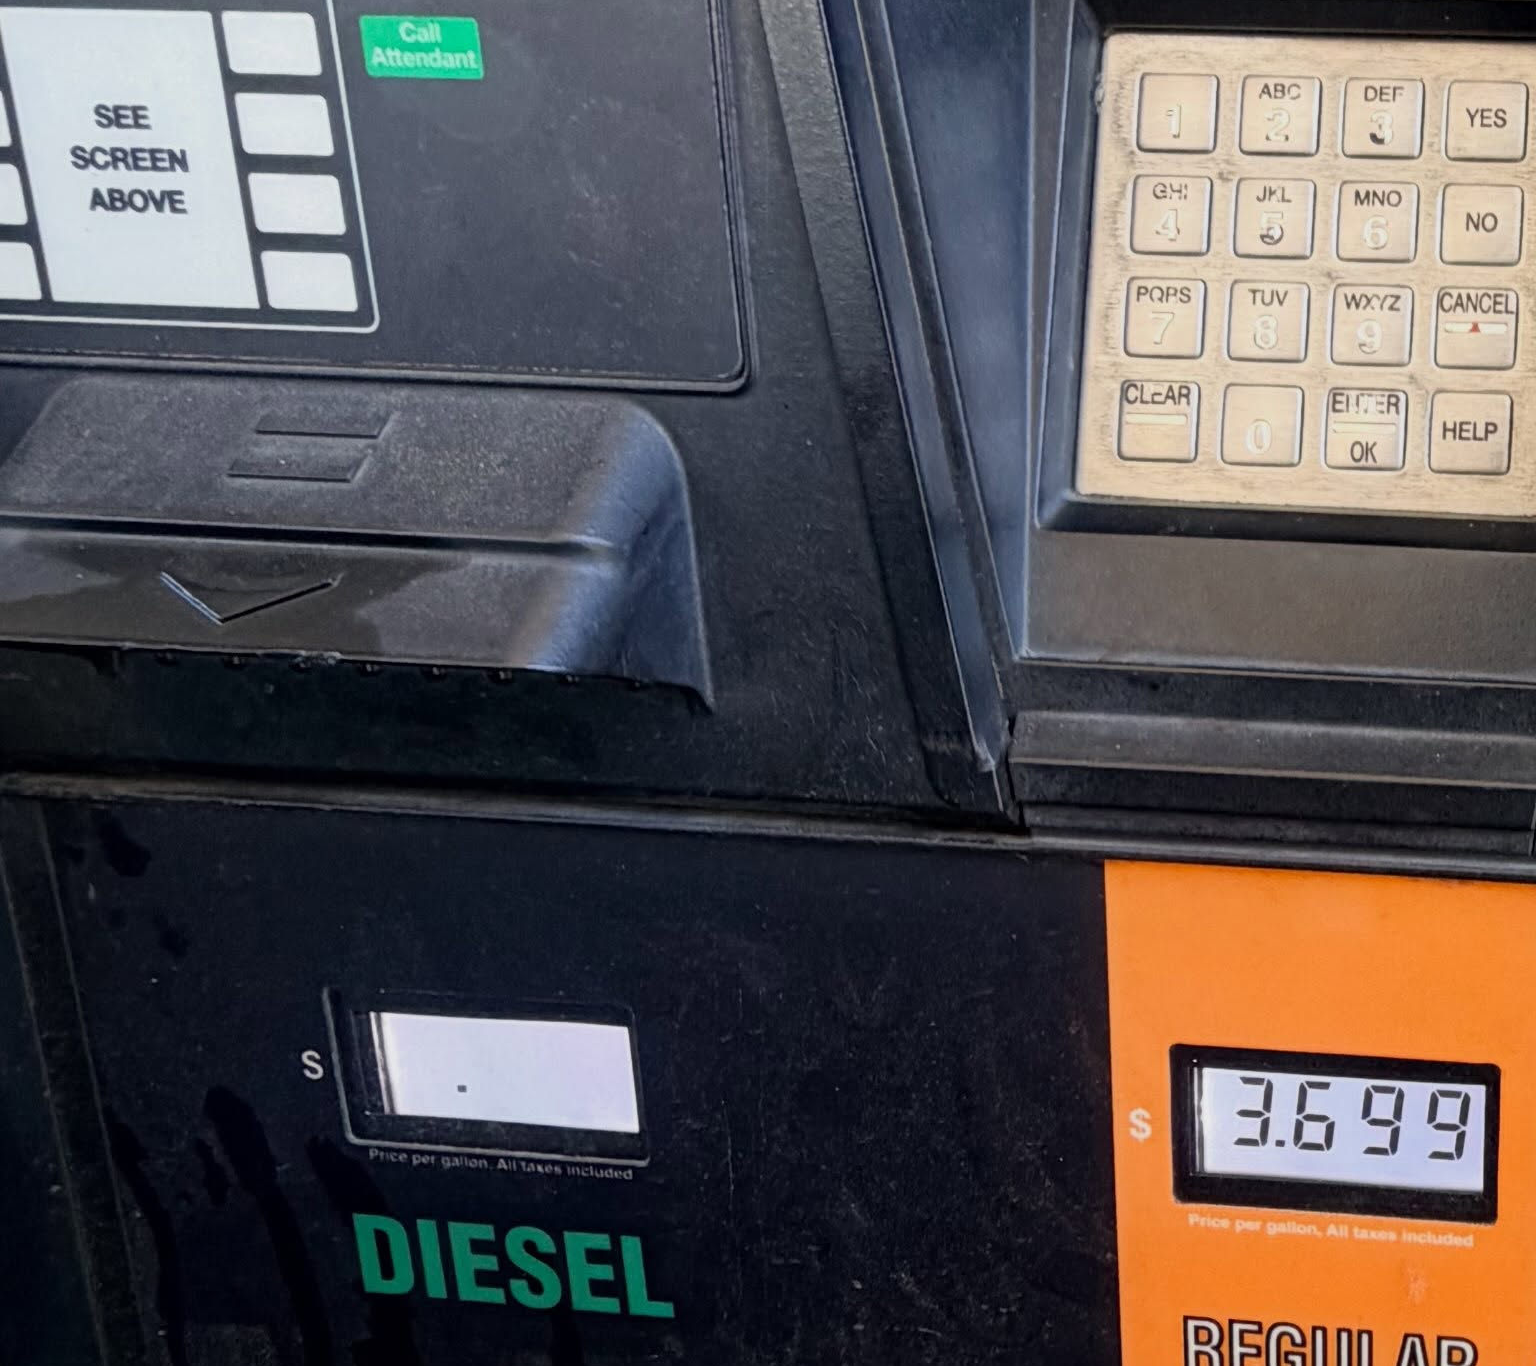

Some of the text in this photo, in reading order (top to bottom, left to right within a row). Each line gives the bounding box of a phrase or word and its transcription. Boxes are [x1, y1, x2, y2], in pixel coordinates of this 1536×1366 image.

[399, 21, 442, 44] Call
[371, 45, 479, 69] Attendant
[1258, 82, 1302, 101] ABC
[1363, 85, 1405, 103] DEF
[94, 104, 151, 131] SEE
[1166, 104, 1182, 139] 1
[1264, 107, 1291, 142] 2
[1369, 109, 1395, 146] 3
[1464, 107, 1508, 129] YES
[71, 146, 189, 174] SCREEN
[89, 188, 188, 215] ABOVE
[1256, 185, 1293, 204] JKL
[1353, 189, 1402, 208] MNO
[1155, 208, 1181, 242] 4
[1259, 210, 1285, 245] 5
[1362, 216, 1390, 251] 6
[1464, 211, 1499, 233] NO
[1248, 288, 1289, 307] TUV
[1438, 291, 1516, 315] CANCEL
[1151, 310, 1176, 345] 7
[1253, 313, 1279, 350] 8
[1356, 318, 1383, 355] 9
[1123, 383, 1191, 407] CLEAR
[1245, 418, 1273, 455] 0
[1441, 420, 1499, 443] HELP
[1350, 440, 1378, 464] OK
[1128, 1107, 1153, 1142] $
[1232, 1076, 1471, 1162] 3.699
[368, 1146, 408, 1163] Price
[412, 1152, 436, 1168] per
[496, 1157, 518, 1172] All
[567, 1164, 634, 1181] included
[1188, 1212, 1230, 1229] Price
[1235, 1220, 1262, 1234] per
[1326, 1223, 1348, 1237] All
[1352, 1226, 1397, 1242] taxes
[1402, 1230, 1474, 1247] included
[352, 1211, 675, 1318] DIESEL
